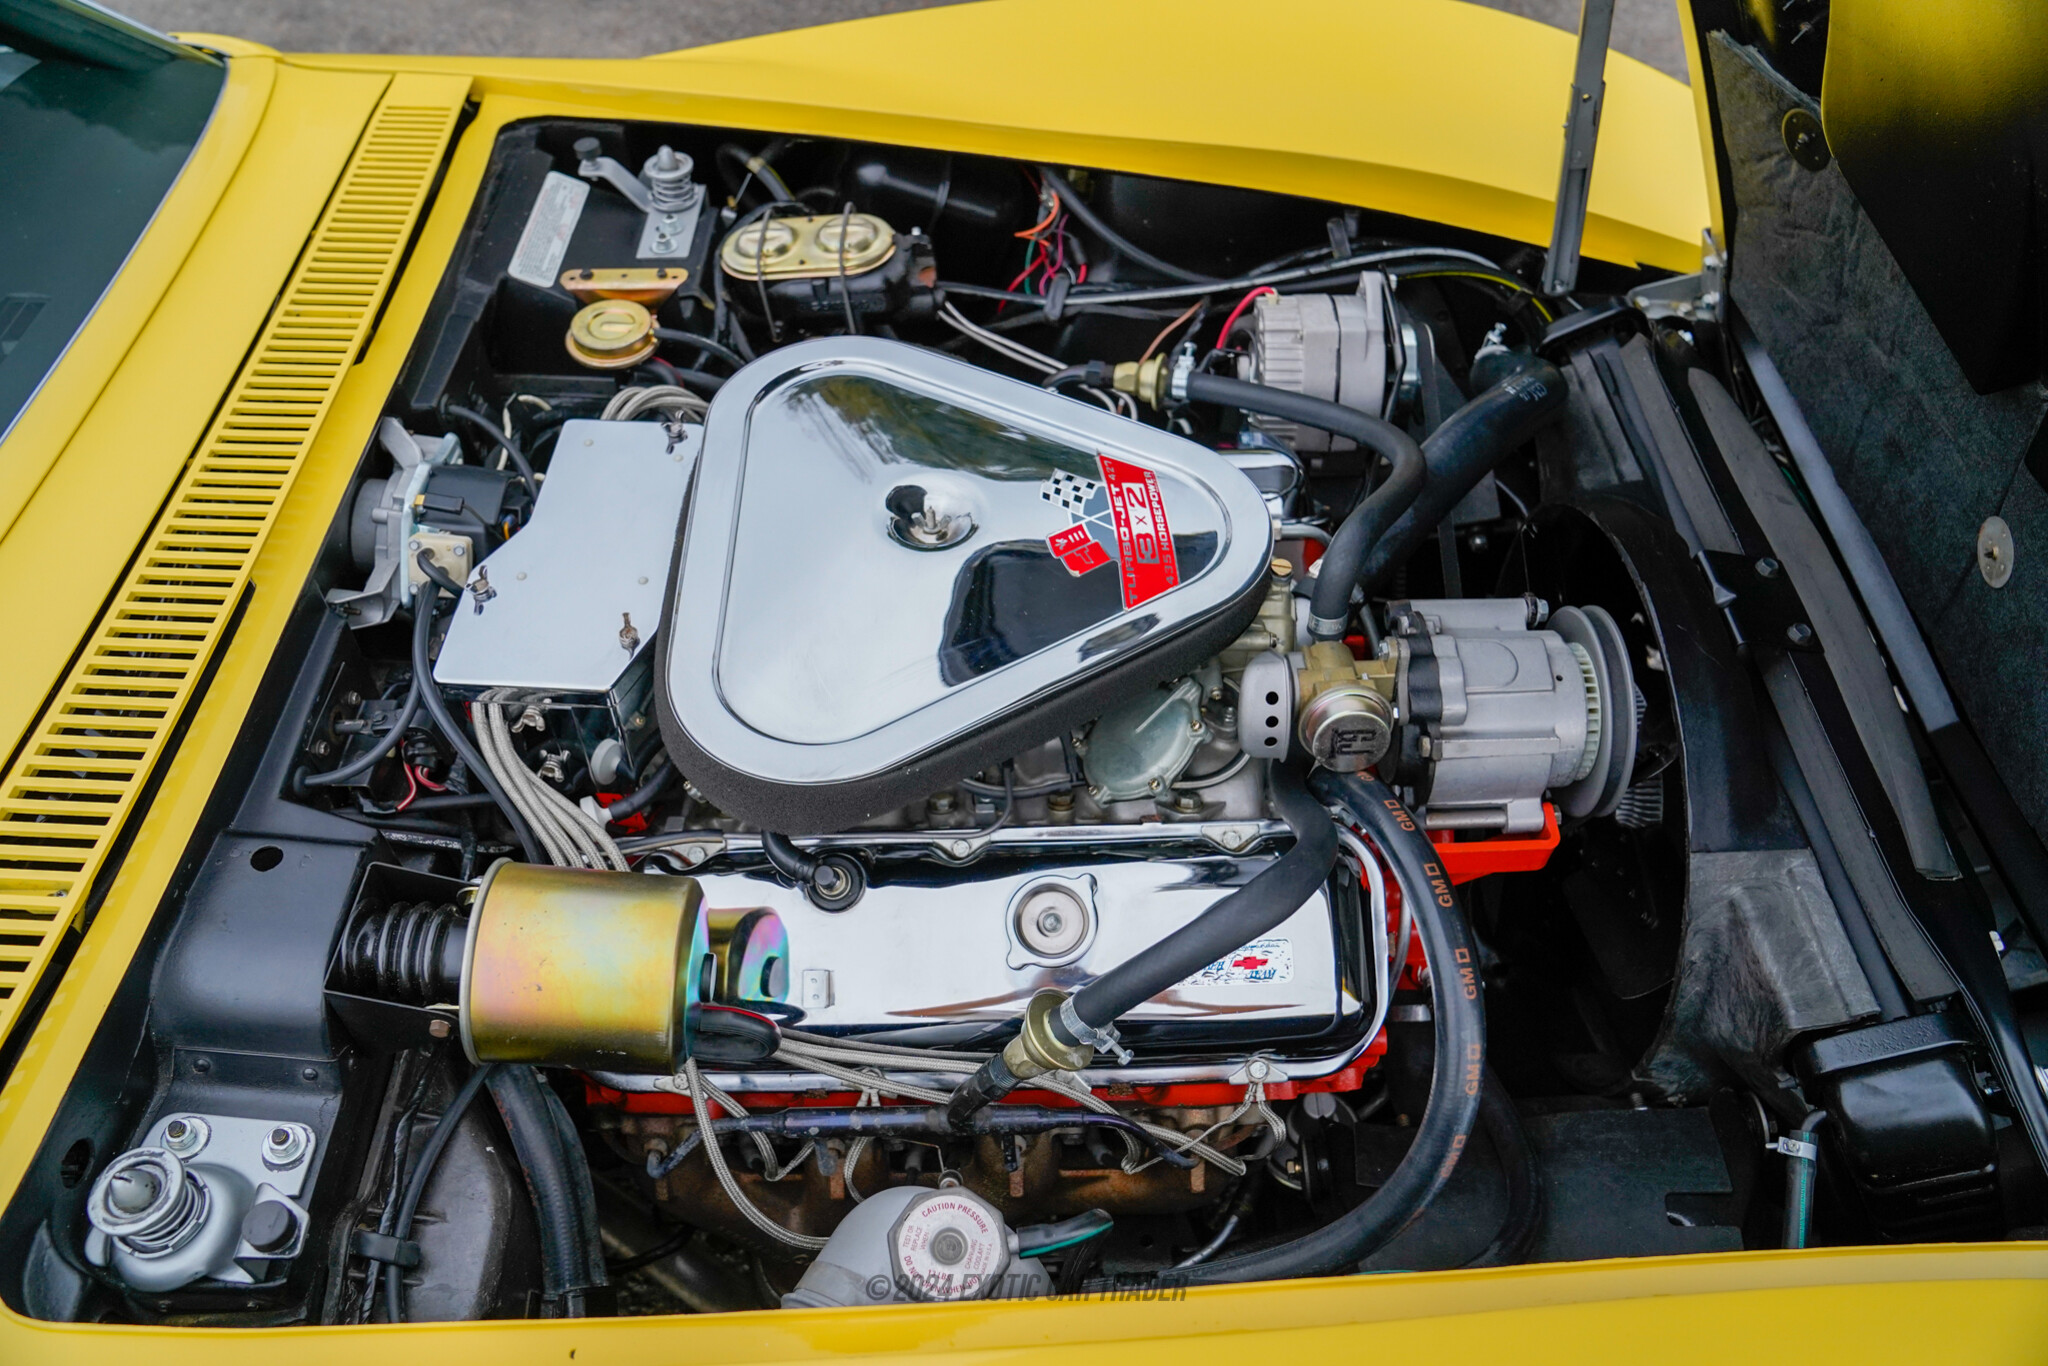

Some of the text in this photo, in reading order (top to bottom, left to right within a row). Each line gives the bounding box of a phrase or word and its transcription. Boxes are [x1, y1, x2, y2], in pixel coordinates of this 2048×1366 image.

[1125, 486, 1147, 509] 2
[1103, 459, 1138, 605] TURBO-JET 427
[1143, 471, 1175, 586] 435 HORSEPOWER
[1135, 532, 1158, 560] 3
[921, 1202, 989, 1235] CAUTION PRESSURE
[910, 1226, 923, 1252] REPLACE
[904, 1255, 913, 1266] DO
[942, 1283, 966, 1294] WHEN
